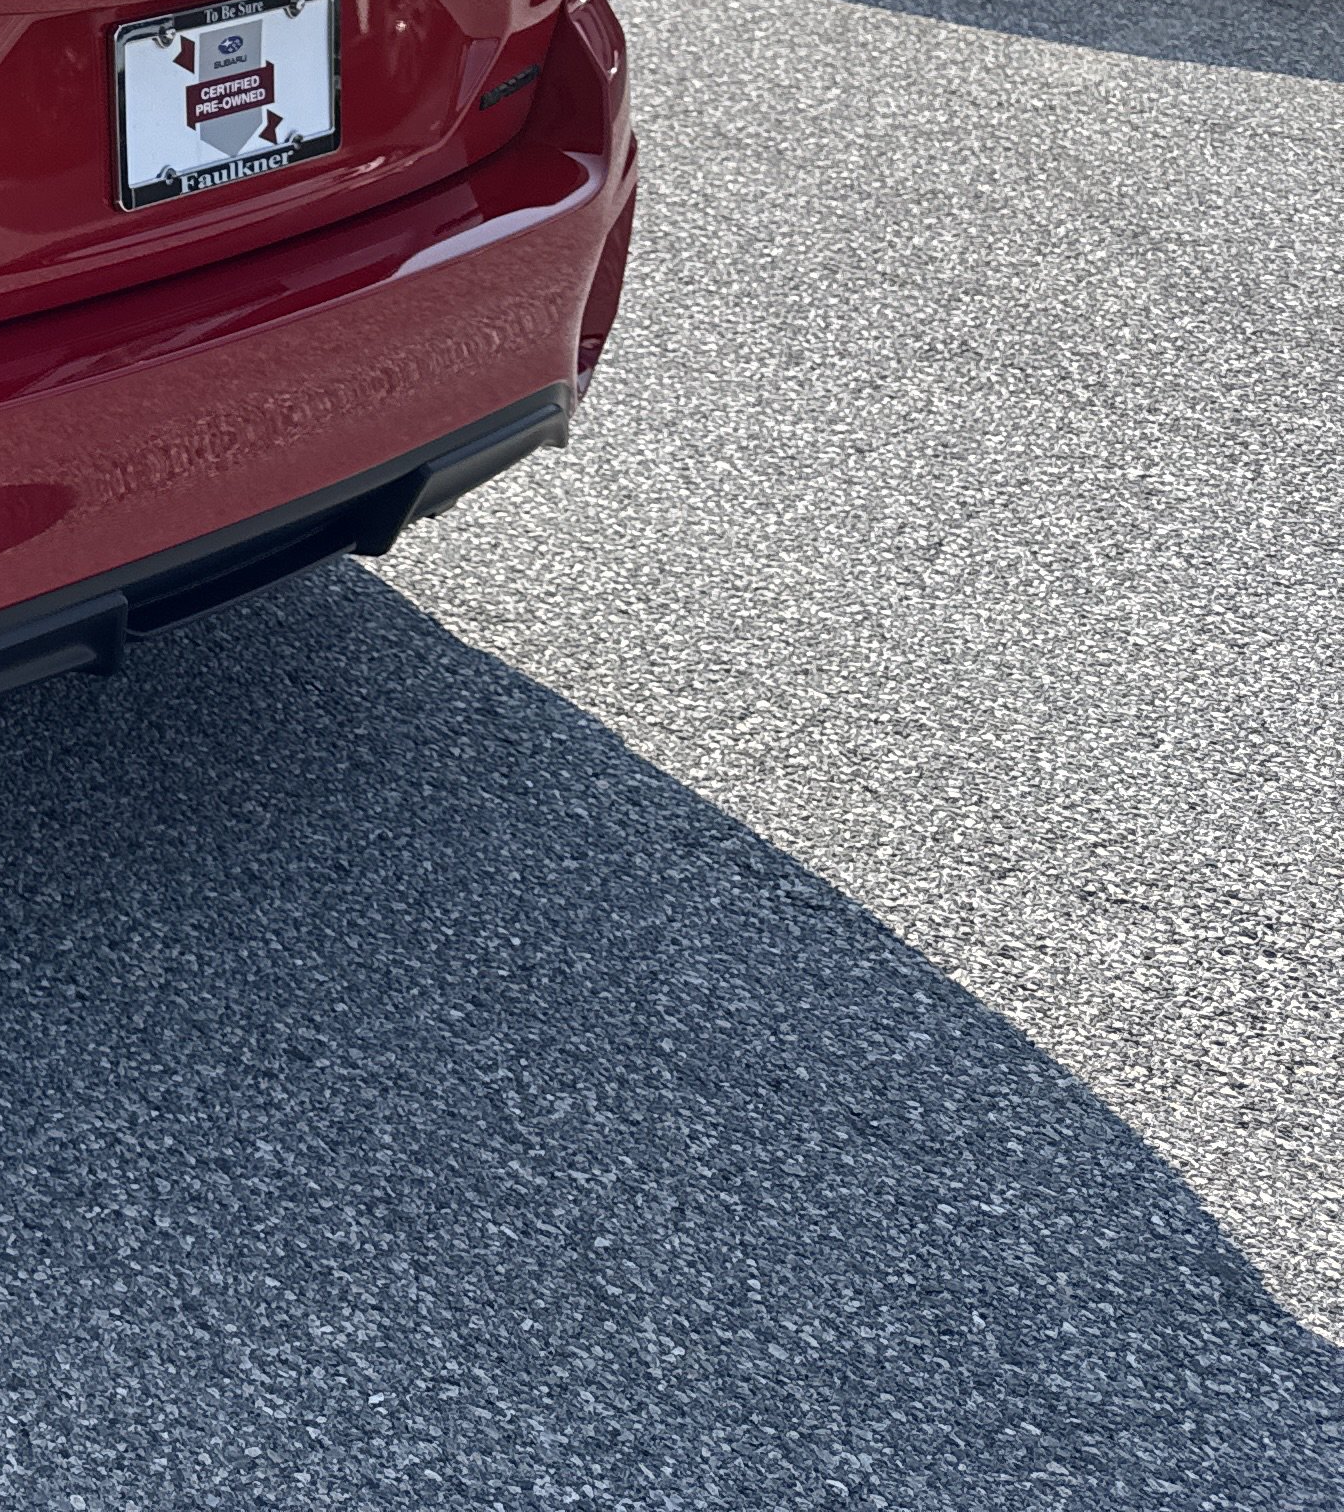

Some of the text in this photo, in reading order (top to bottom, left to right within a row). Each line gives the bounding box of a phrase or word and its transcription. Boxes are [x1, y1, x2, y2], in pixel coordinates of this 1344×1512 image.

[204, 1, 264, 24] To Be Sure
[213, 54, 248, 69] SUBARU
[200, 75, 260, 100] CERTIFIED
[195, 88, 266, 117] PRE-OWNED
[180, 150, 294, 195] Faulkner
